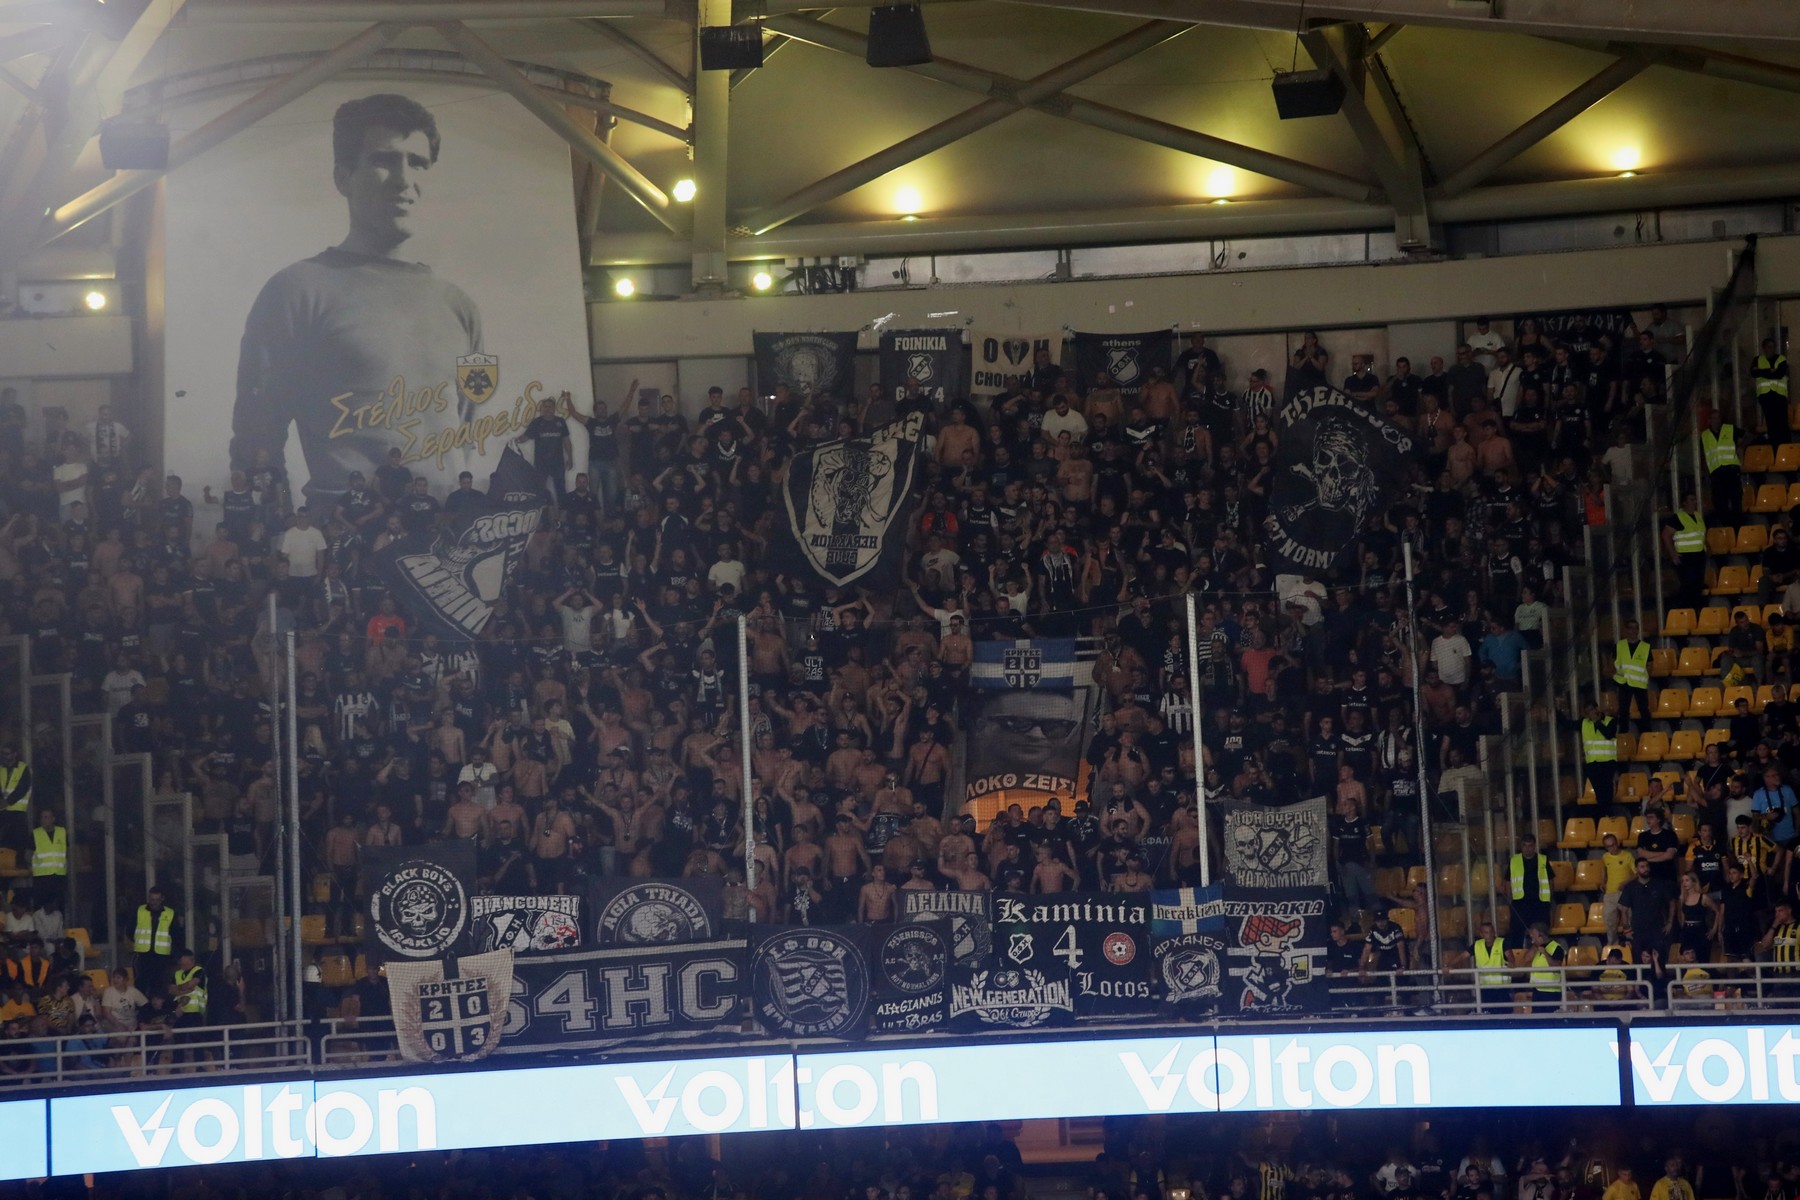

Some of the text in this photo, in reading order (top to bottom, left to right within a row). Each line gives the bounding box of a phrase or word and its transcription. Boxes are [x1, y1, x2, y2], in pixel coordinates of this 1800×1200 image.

[895, 336, 947, 351] FOINIKIA
[1102, 338, 1142, 348] athens
[329, 375, 448, 439] Στέλιος
[934, 386, 945, 403] 4
[397, 380, 570, 471] Σεραφείδς
[1278, 537, 1337, 570] NORM
[1023, 774, 1075, 800] ΖΕΙΣ!
[381, 868, 453, 896] BLACK BOYS
[472, 896, 579, 919] BIANCONERI
[603, 888, 705, 931] AGIA TRIADA
[996, 898, 1146, 924] Kaminia
[388, 927, 451, 948] IRAKLIO
[1052, 924, 1084, 970] 4
[419, 978, 486, 997] ΚΡΗΤΕΣ
[1076, 971, 1149, 998] Locos
[428, 996, 481, 1020] 2 0
[899, 992, 943, 1012] GIANNIS
[431, 1027, 485, 1051] 0 3
[1119, 1035, 1431, 1111] volton
[615, 1055, 939, 1135] volton
[110, 1084, 437, 1168] volton
